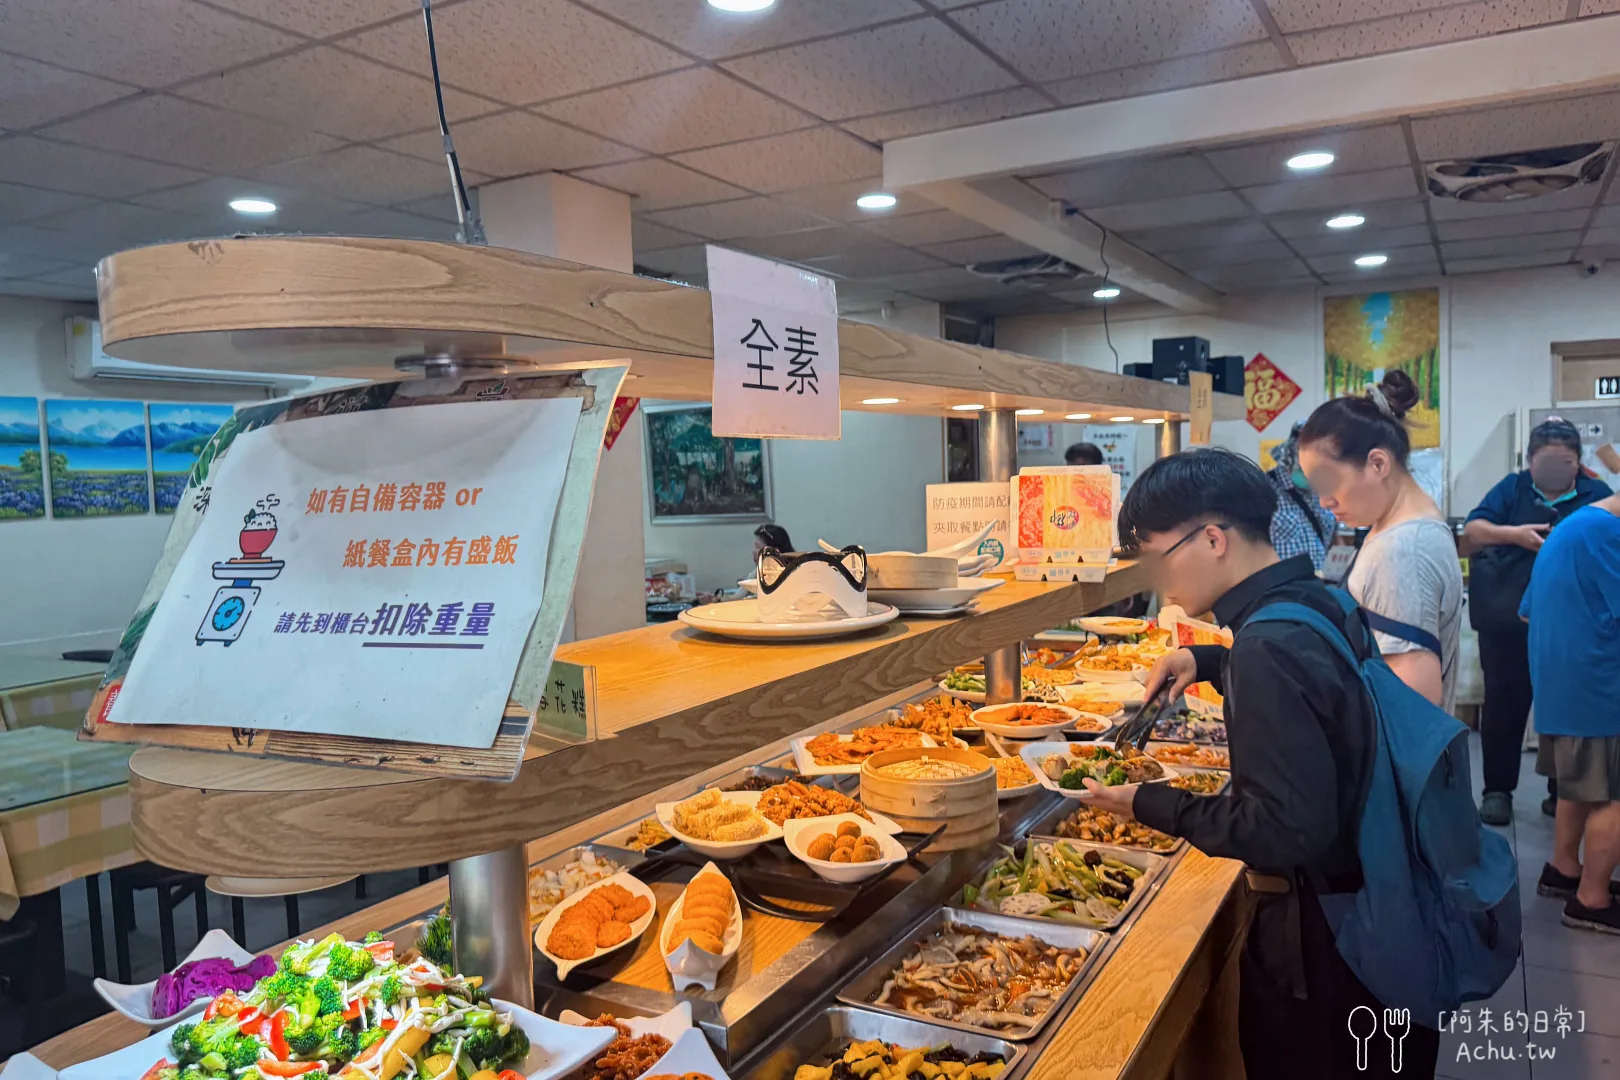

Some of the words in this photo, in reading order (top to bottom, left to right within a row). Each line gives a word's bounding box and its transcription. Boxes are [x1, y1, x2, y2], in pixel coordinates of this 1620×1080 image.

[740, 318, 819, 395] 全素
[1244, 368, 1281, 412] 福
[306, 482, 446, 515] 如有自備容器
[455, 483, 483, 507] or
[932, 495, 1010, 510] 防疫期間請配
[342, 534, 519, 569] 紙餐盒內有盛飯
[273, 602, 496, 637] 請先到櫃台扣除重量
